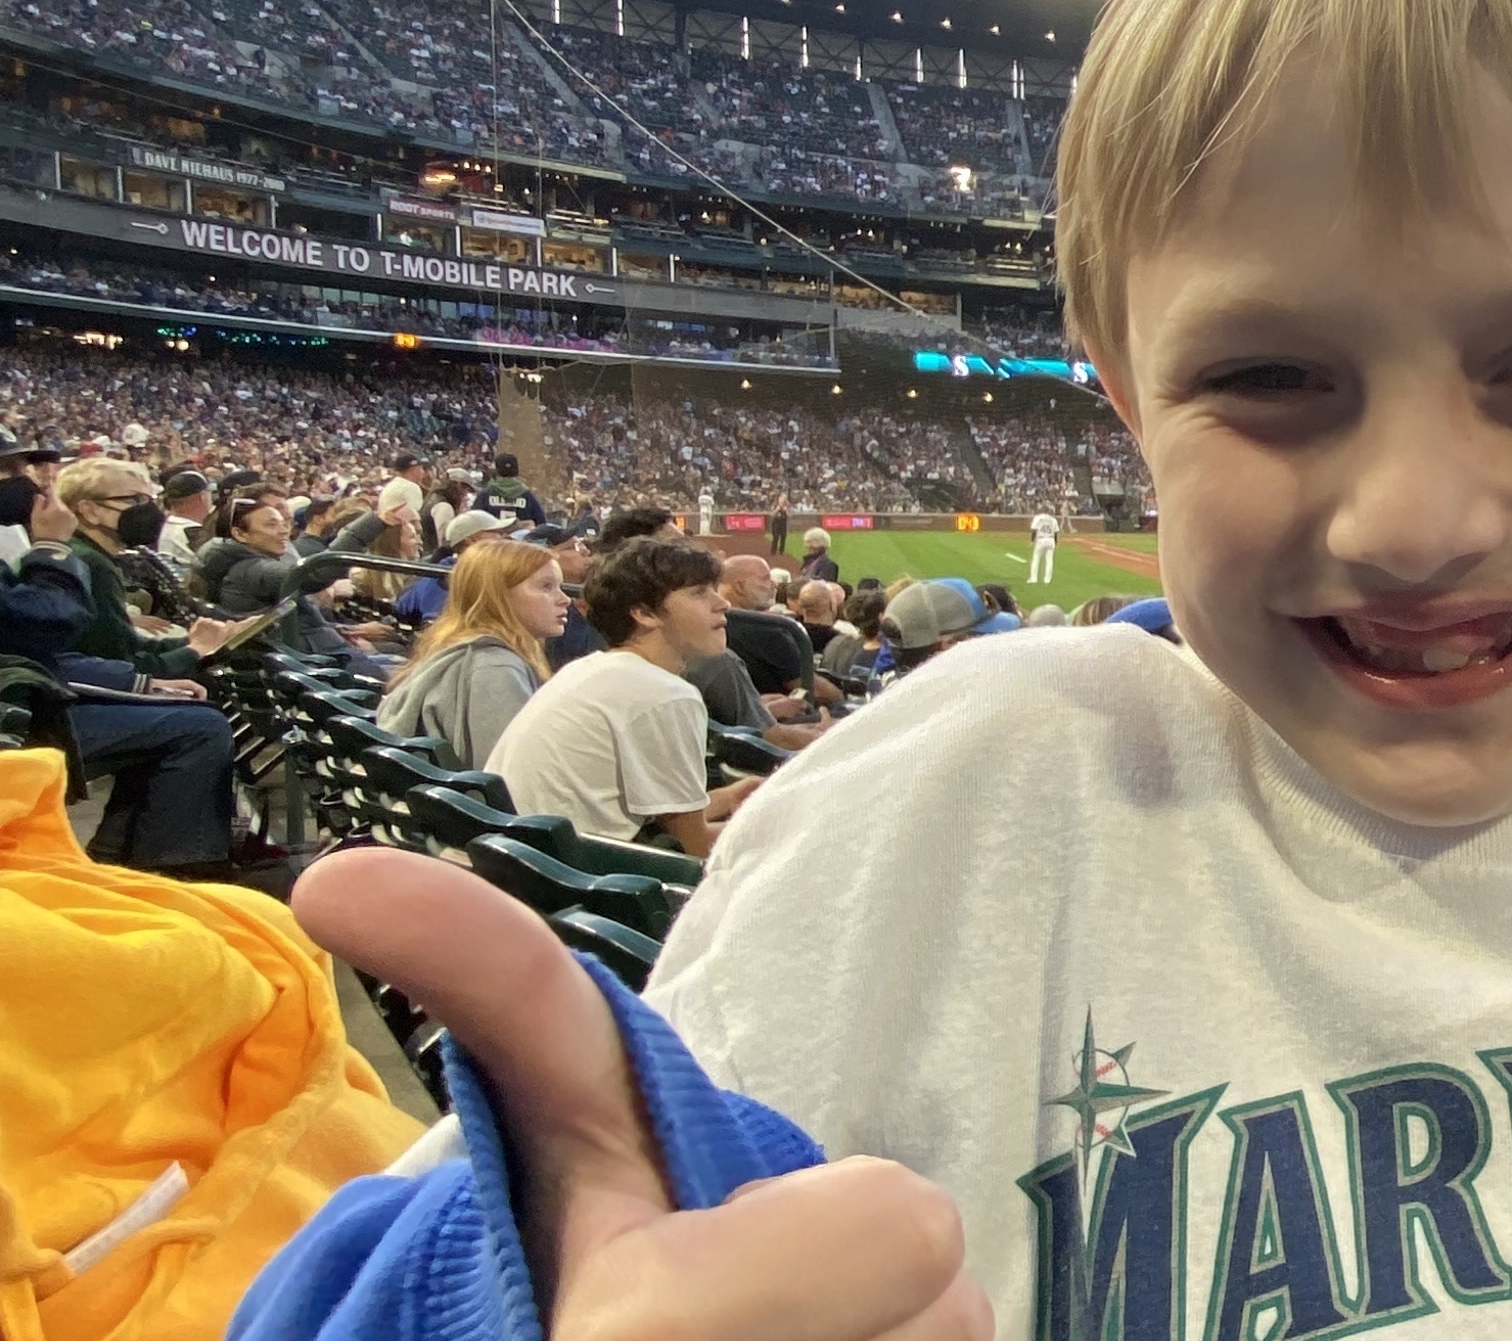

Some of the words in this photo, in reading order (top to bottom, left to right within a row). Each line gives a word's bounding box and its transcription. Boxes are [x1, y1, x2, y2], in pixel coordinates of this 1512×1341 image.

[145, 151, 179, 171] DAVE
[181, 219, 323, 266] WELCOME
[332, 244, 370, 272] TO
[380, 252, 502, 288] T-MOBILE
[508, 268, 577, 297] PARK
